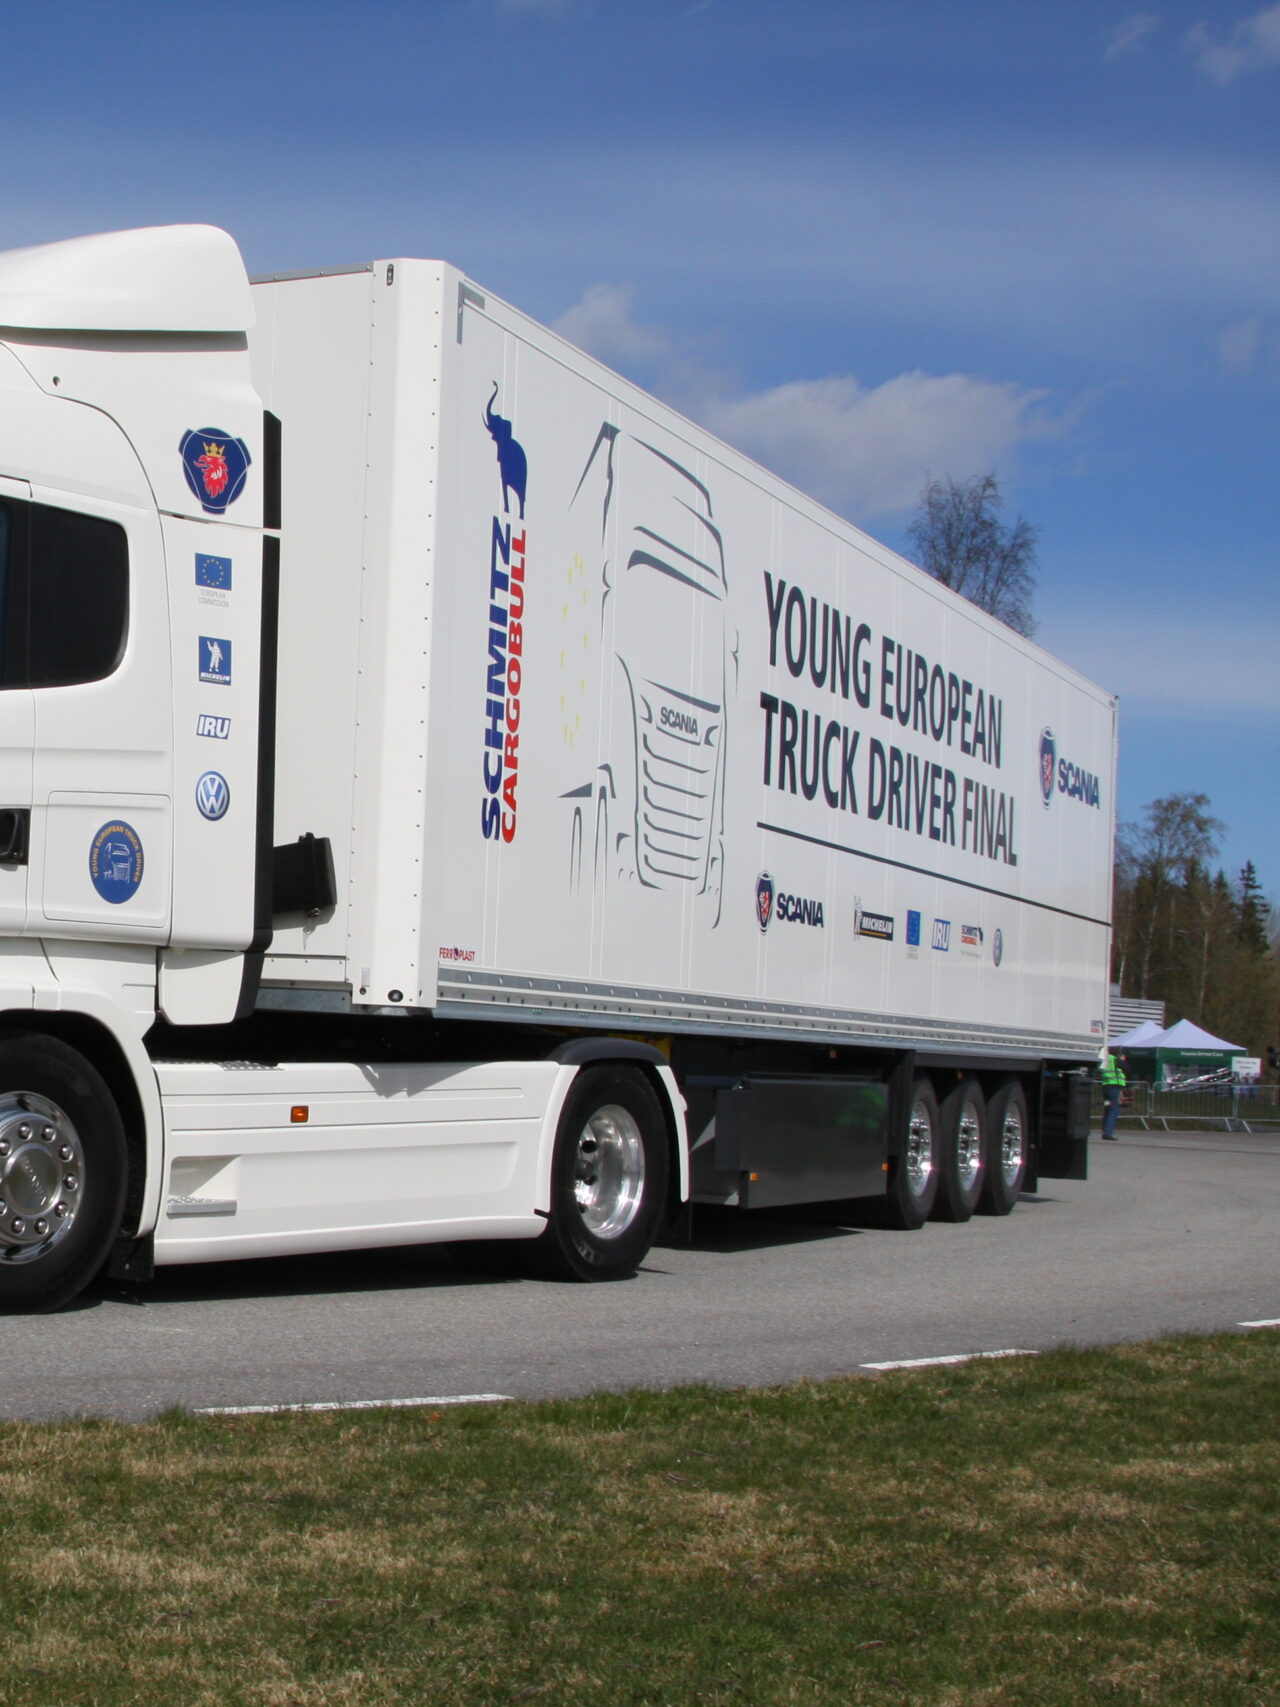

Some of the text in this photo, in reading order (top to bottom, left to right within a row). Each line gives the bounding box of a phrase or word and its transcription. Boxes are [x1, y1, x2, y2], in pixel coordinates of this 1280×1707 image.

[200, 672, 230, 681] MICHELIN
[481, 515, 511, 841] SCHMITZ
[502, 529, 526, 843] CARGOBULL
[763, 570, 1002, 769] YOUNG EUROPEAN
[198, 716, 229, 738] IRU
[660, 706, 698, 736] SCANIA
[760, 691, 1017, 867] TRUCK DRIVER FINAL
[1058, 758, 1100, 810] SCANIA
[776, 892, 824, 928] SCANIA
[932, 921, 949, 949] IRU
